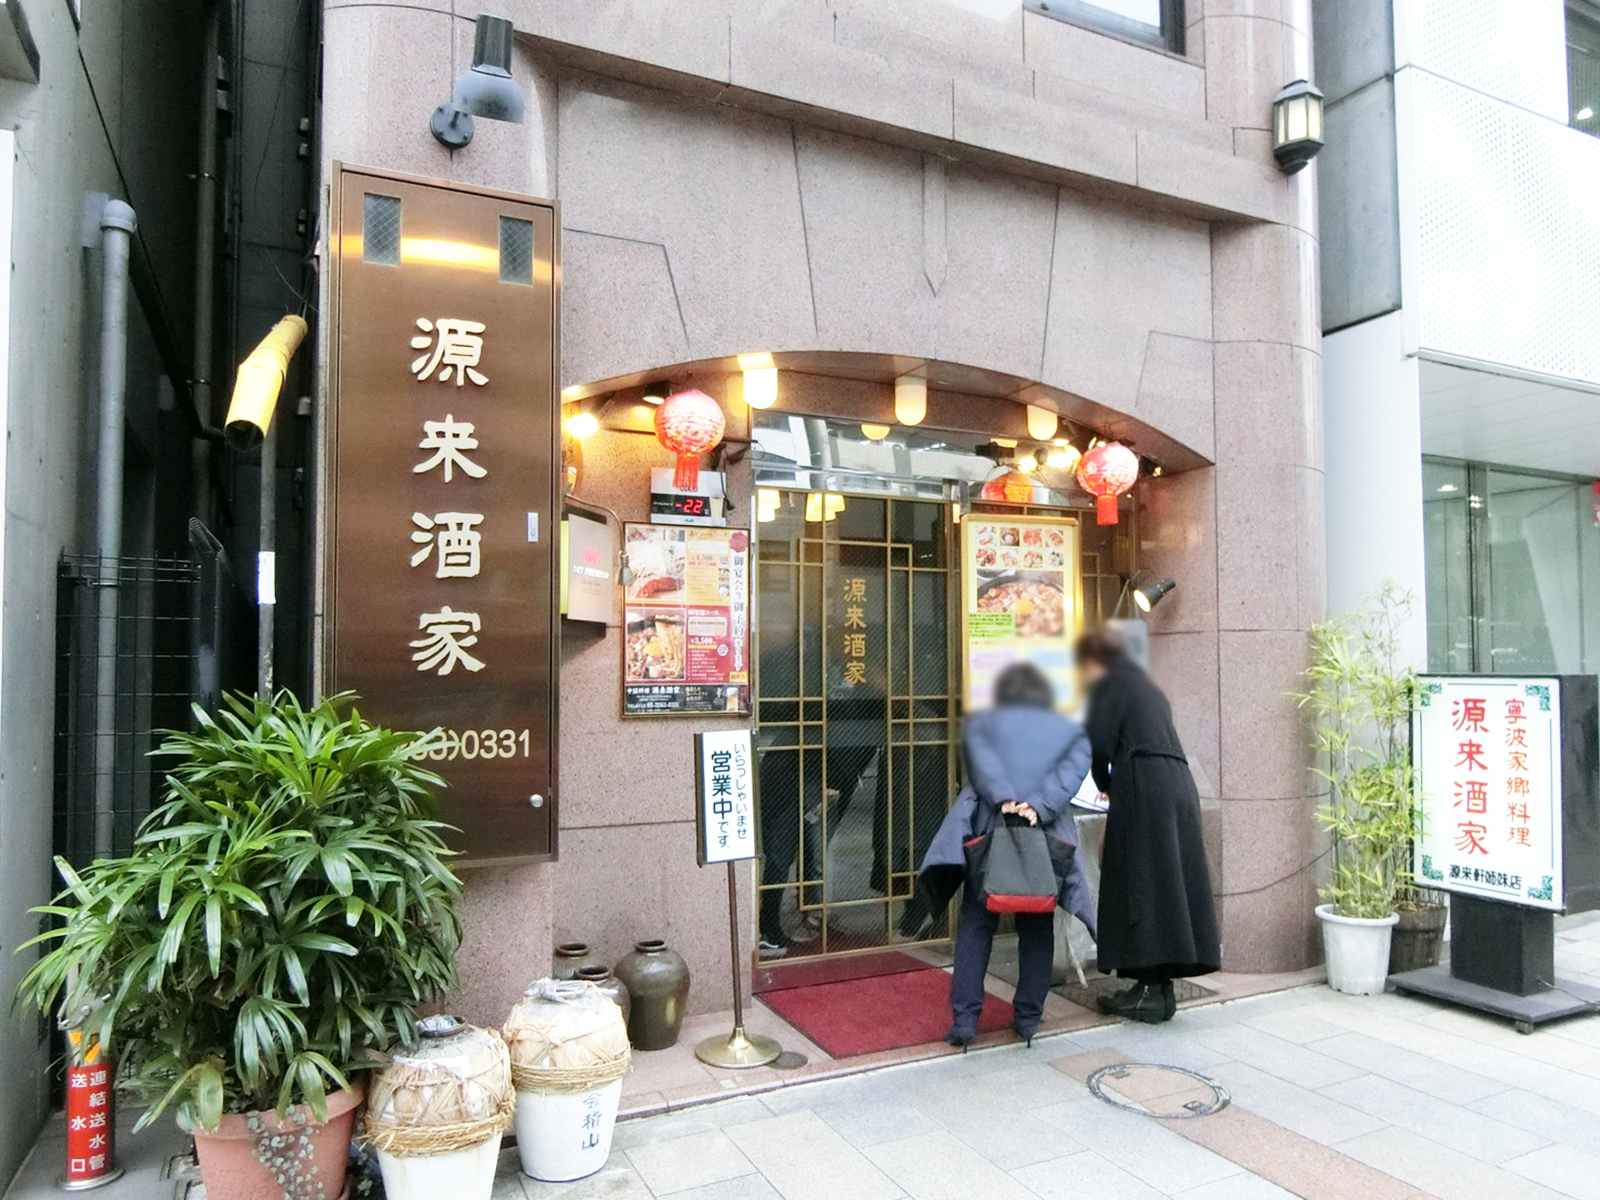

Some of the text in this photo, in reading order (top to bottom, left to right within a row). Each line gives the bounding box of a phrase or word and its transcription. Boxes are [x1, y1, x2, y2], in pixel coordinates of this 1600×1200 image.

[409, 316, 490, 676] 源来酒家
[674, 498, 704, 514] -22
[843, 578, 867, 685] 源来酒家
[1451, 698, 1489, 855] 源来酒家
[1505, 698, 1531, 848] 寧波家郷料理
[1448, 864, 1522, 890] 源来軒姉妹店
[71, 1073, 88, 1173] 送水口
[89, 1070, 107, 1171] 連結送水管
